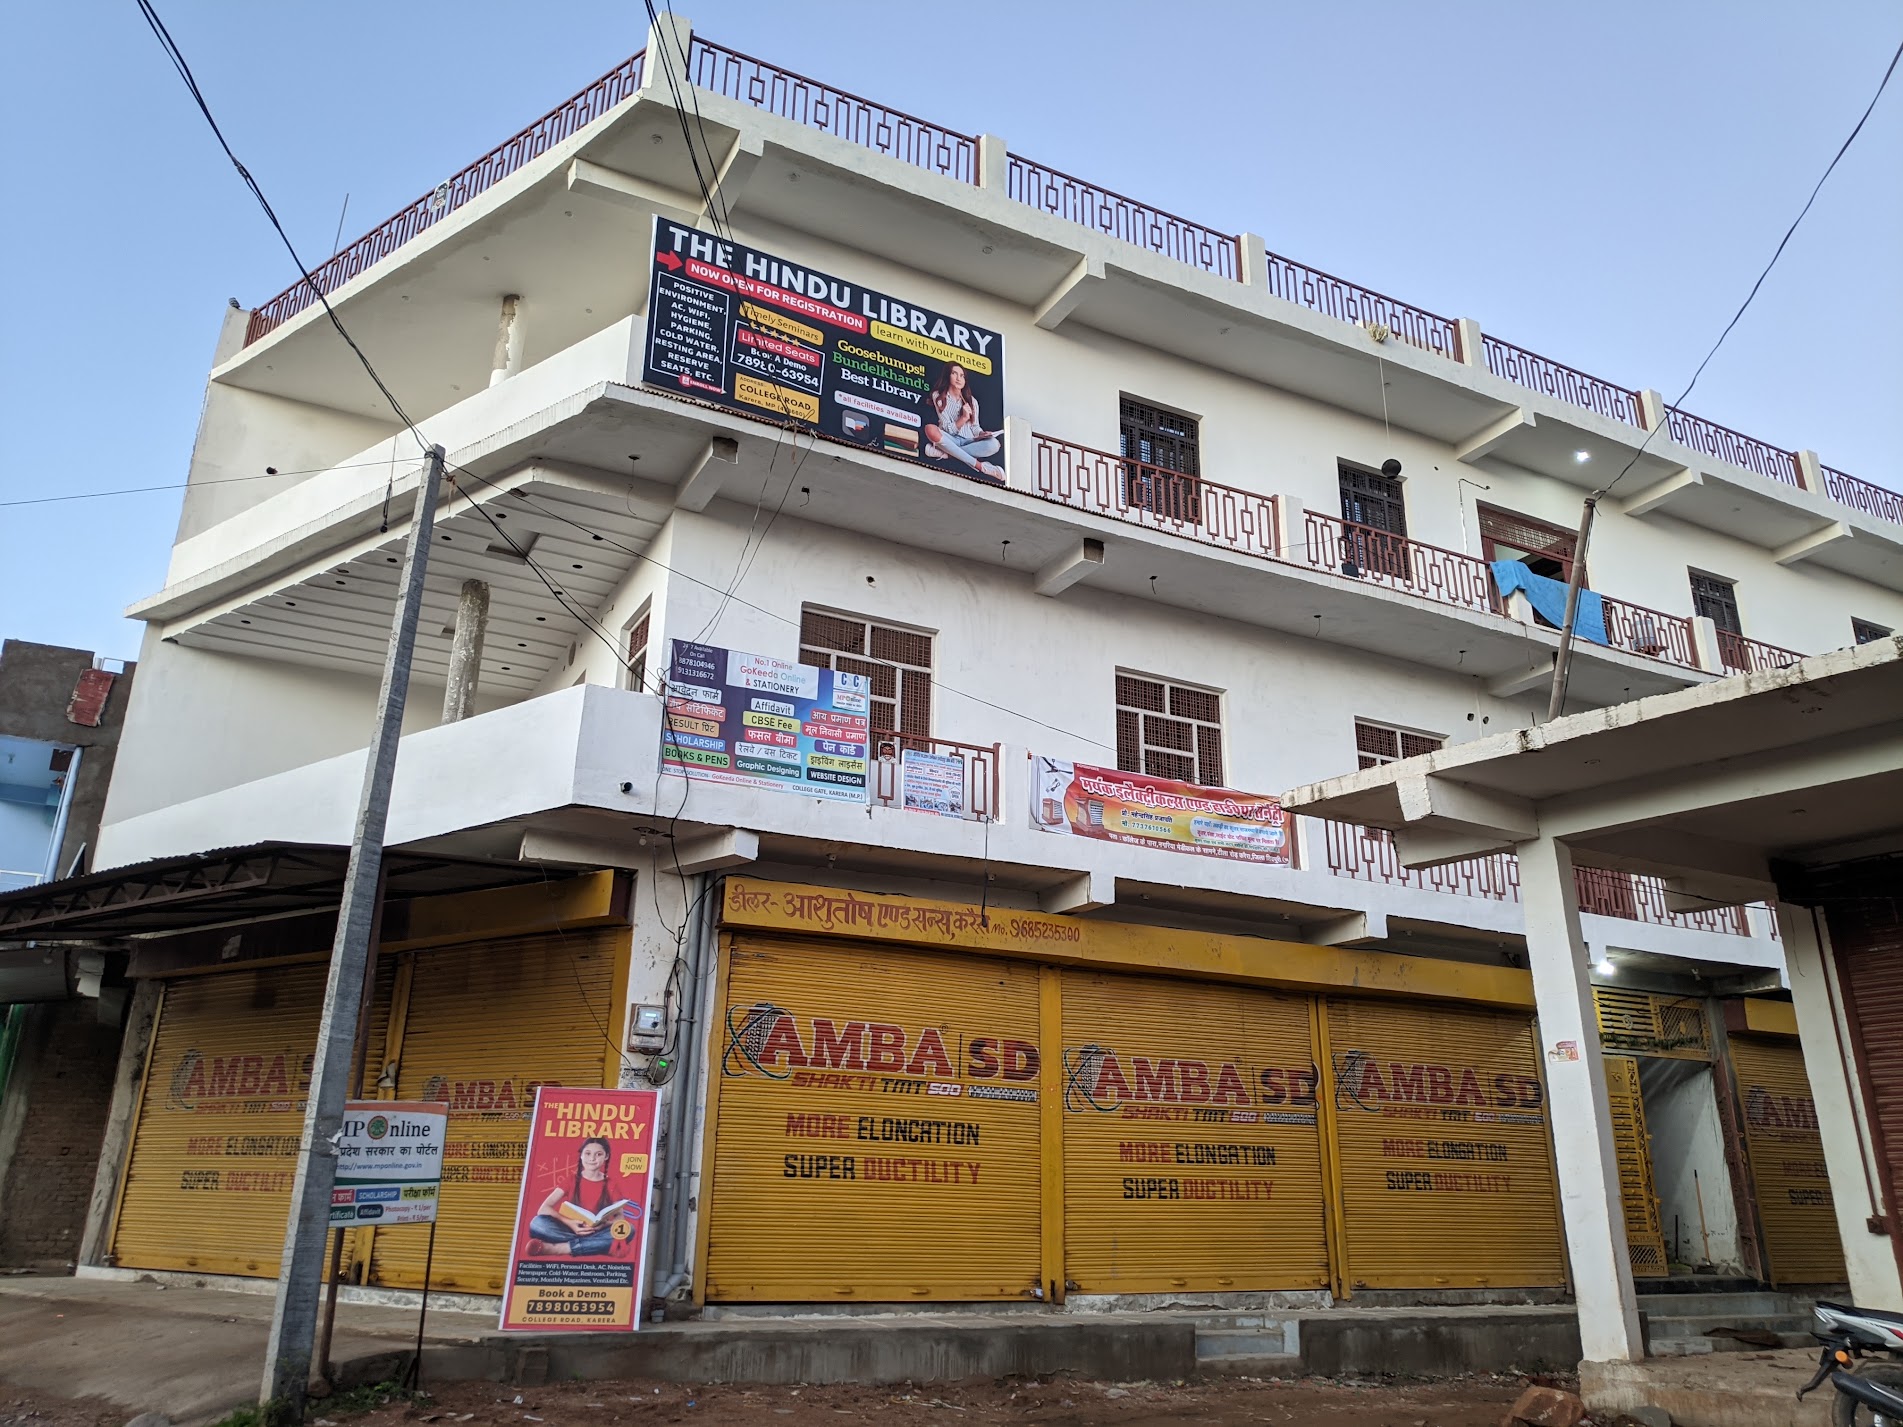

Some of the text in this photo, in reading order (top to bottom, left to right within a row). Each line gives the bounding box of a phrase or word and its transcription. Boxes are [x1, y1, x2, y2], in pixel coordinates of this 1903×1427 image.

[659, 287, 727, 315] ENVIRONMENT,
[669, 226, 993, 356] THE HINDU LIBRARY
[673, 281, 715, 301] POSITIVE
[691, 263, 863, 329] NOW OPEN FOR REGISTRATION
[671, 301, 711, 320] AC, WIFI,
[670, 311, 712, 331] HYGIENE,
[670, 321, 713, 341] PARKING,
[745, 305, 819, 341] Timely Seminars
[655, 337, 723, 364] RESTING AREA,
[660, 328, 720, 353] COLD WATER,
[741, 332, 815, 363] Limited Seats
[876, 325, 987, 370] learn with your mates
[667, 352, 710, 370] RESERVE
[774, 354, 781, 364] A
[783, 357, 807, 371] Demo
[837, 339, 926, 377] Goosebumps!!
[660, 360, 715, 382] SEATS, ETC.
[737, 353, 819, 388] 78980-63954
[832, 350, 930, 392] Bundelkhand's
[840, 367, 922, 404] Best Library
[739, 383, 811, 411] COLLEGE ROAD
[853, 398, 884, 413] facilities
[886, 408, 918, 424] available
[755, 657, 793, 671] No.1 Online
[740, 665, 806, 684] GoKeeda Online
[745, 678, 799, 694] & STATIONERY
[754, 701, 791, 715] Affidavit
[812, 711, 827, 720] आय
[830, 714, 851, 725] प्रमाण
[668, 717, 699, 731] RESULT
[751, 715, 793, 730] CBSE Fee
[805, 725, 818, 736] मूल
[819, 725, 843, 738] निवासी
[665, 733, 724, 750] SCHOLARSHIP
[748, 730, 772, 742] फसल
[665, 747, 729, 766] BOOKS & PENS
[738, 743, 755, 754] रेलवे
[779, 748, 798, 760] टिकट
[822, 742, 856, 756] पेन कार्ड
[736, 760, 800, 778] Graphic Designing
[810, 771, 862, 785] WEBSITE DESIGN
[792, 785, 813, 793] COLLEGE
[783, 892, 876, 931] आशुतोष
[877, 902, 911, 931] एण्ड
[1010, 918, 1080, 943] 9685235300
[759, 1015, 1041, 1082] AMBA SD
[181, 1054, 289, 1098] AMBA
[791, 1071, 962, 1096] SHAKTI TMT 500
[1093, 1054, 1320, 1107] AMBA SD
[1358, 1060, 1544, 1109] AMBA SD
[543, 1102, 636, 1121] THE HINDU
[1122, 1105, 1188, 1121] SHAKTI
[1192, 1108, 1229, 1122] TMT
[544, 1120, 646, 1140] LIBRARY
[785, 1112, 851, 1140] MORE
[339, 1143, 439, 1158] प्रदेश सरकार का पोर्टल
[1119, 1141, 1276, 1166] MORE ELONGATION
[1382, 1138, 1426, 1158] MORE
[784, 1153, 982, 1184] SUPER DUCTILITY
[1122, 1177, 1275, 1201] SUPER DUCTILITY
[1386, 1171, 1511, 1193] SUPER DUCTILITY
[358, 1190, 398, 1201] SCHOLARSHIP
[539, 1290, 565, 1298] Book
[576, 1290, 607, 1298] Demo
[528, 1301, 614, 1313] 7898063954
